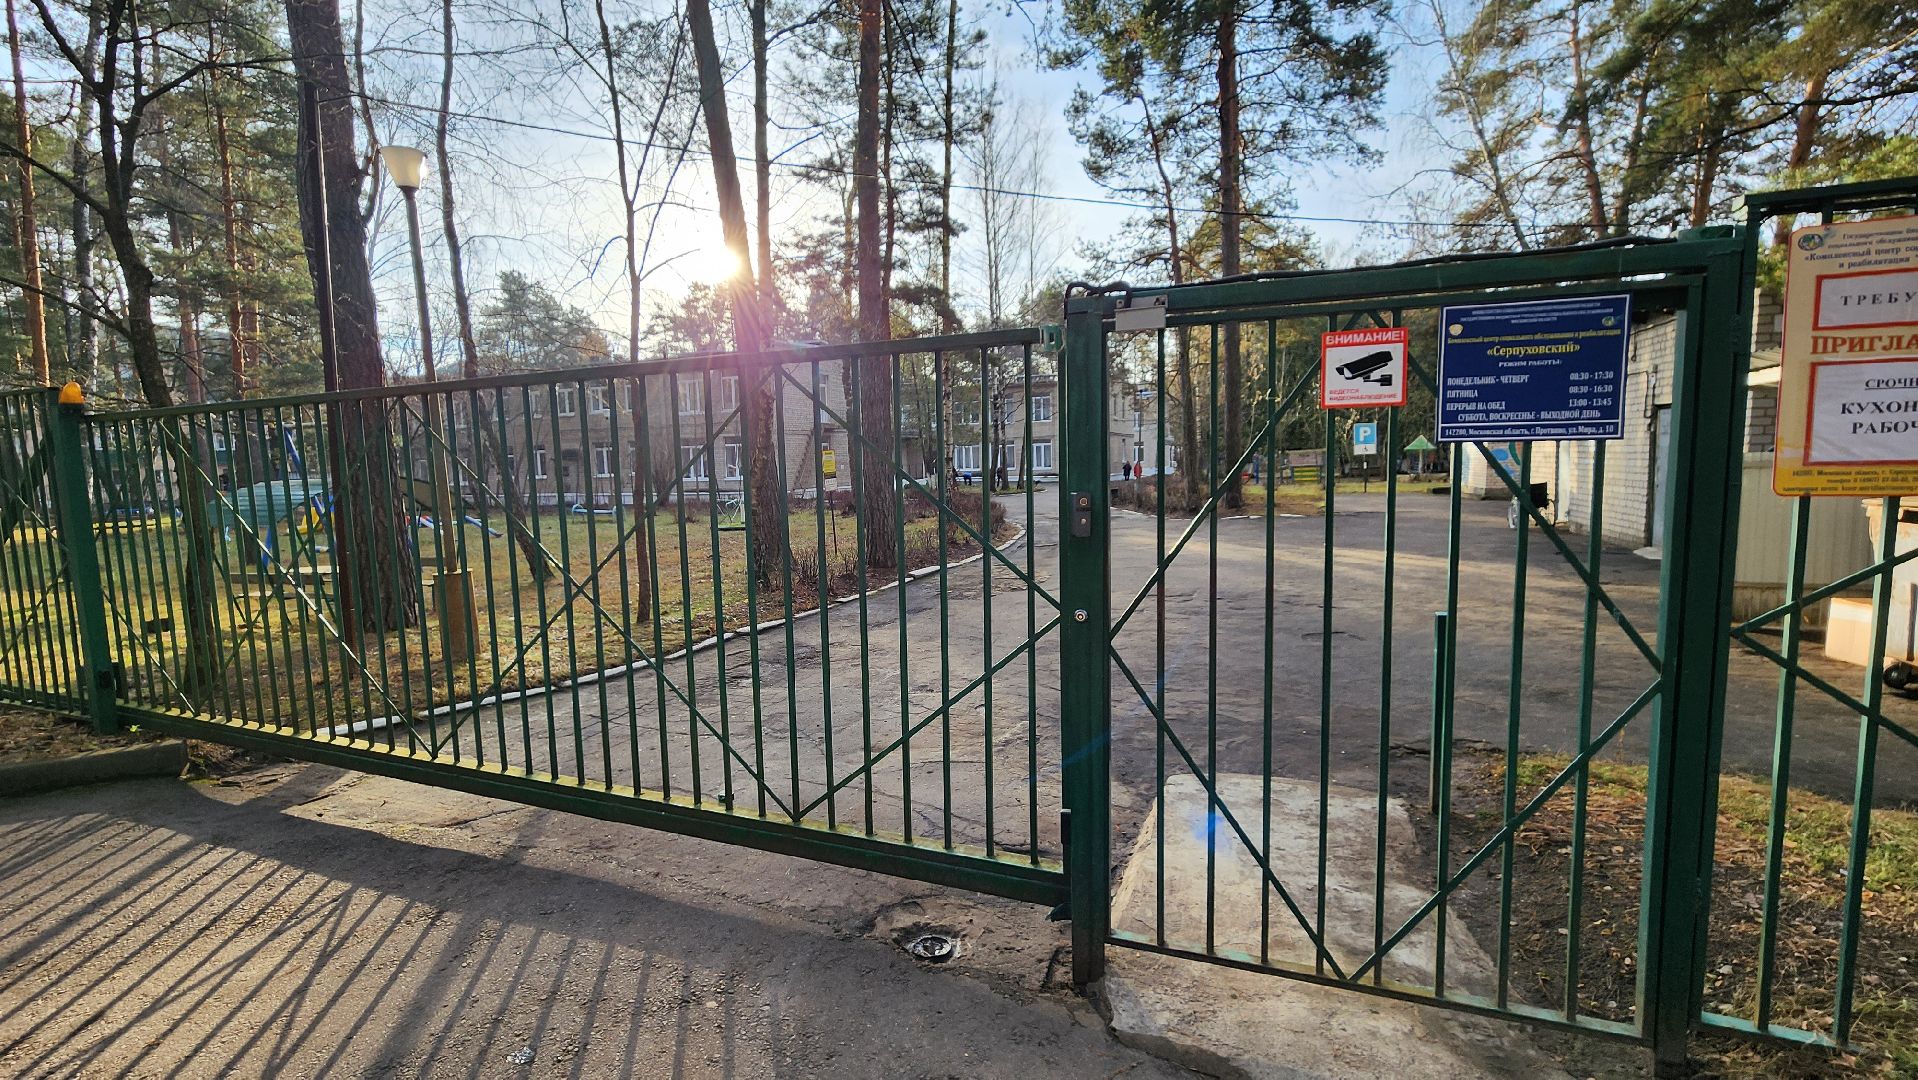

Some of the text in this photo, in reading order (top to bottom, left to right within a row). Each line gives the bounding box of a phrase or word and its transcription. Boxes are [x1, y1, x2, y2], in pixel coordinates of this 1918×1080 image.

[1875, 247, 1901, 256] центр
[1326, 331, 1404, 345] ВНИМАНИЕ!
[1487, 341, 1580, 358] «Серпуховский»
[1529, 359, 1562, 367] РАБОТЫ:
[1501, 374, 1530, 385] ЧЕТВЕРГ
[1569, 371, 1589, 381] 08:30
[1595, 371, 1614, 380] 17:30
[1447, 389, 1478, 398] ПЯТНИЦА
[1569, 385, 1588, 394] 08:30
[1594, 384, 1613, 393] 16:30
[1446, 400, 1506, 411] ПЕРЕРЫВ НА ОБЕД
[1569, 398, 1588, 407] 13:00
[1593, 397, 1612, 406] 13:45
[1458, 413, 1489, 422] СУББОТА,
[1490, 411, 1536, 420] ВОСКРЕСЕНЬЕ
[1541, 409, 1580, 420] ВЫХОДНОЙ
[1581, 409, 1601, 419] ДЕНЬ
[1359, 426, 1371, 441] P
